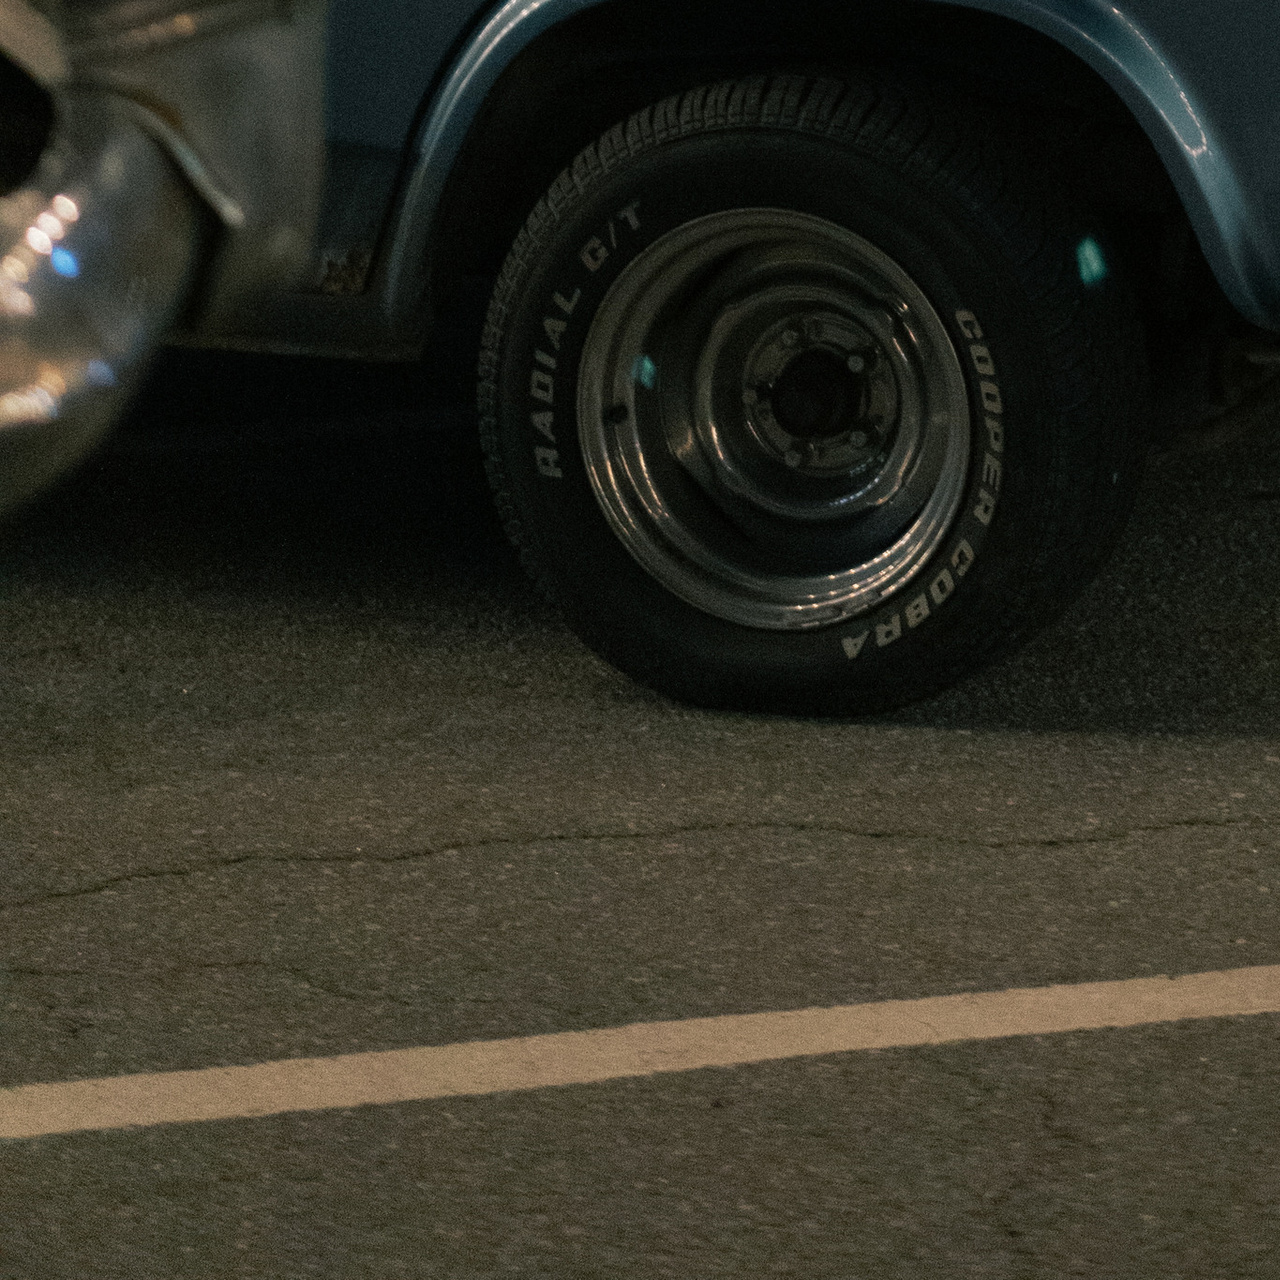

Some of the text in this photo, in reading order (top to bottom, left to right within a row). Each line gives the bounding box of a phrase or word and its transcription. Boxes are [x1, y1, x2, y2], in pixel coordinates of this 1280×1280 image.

[531, 287, 581, 478] RADIAL
[842, 308, 1004, 659] COOPER COBRA
